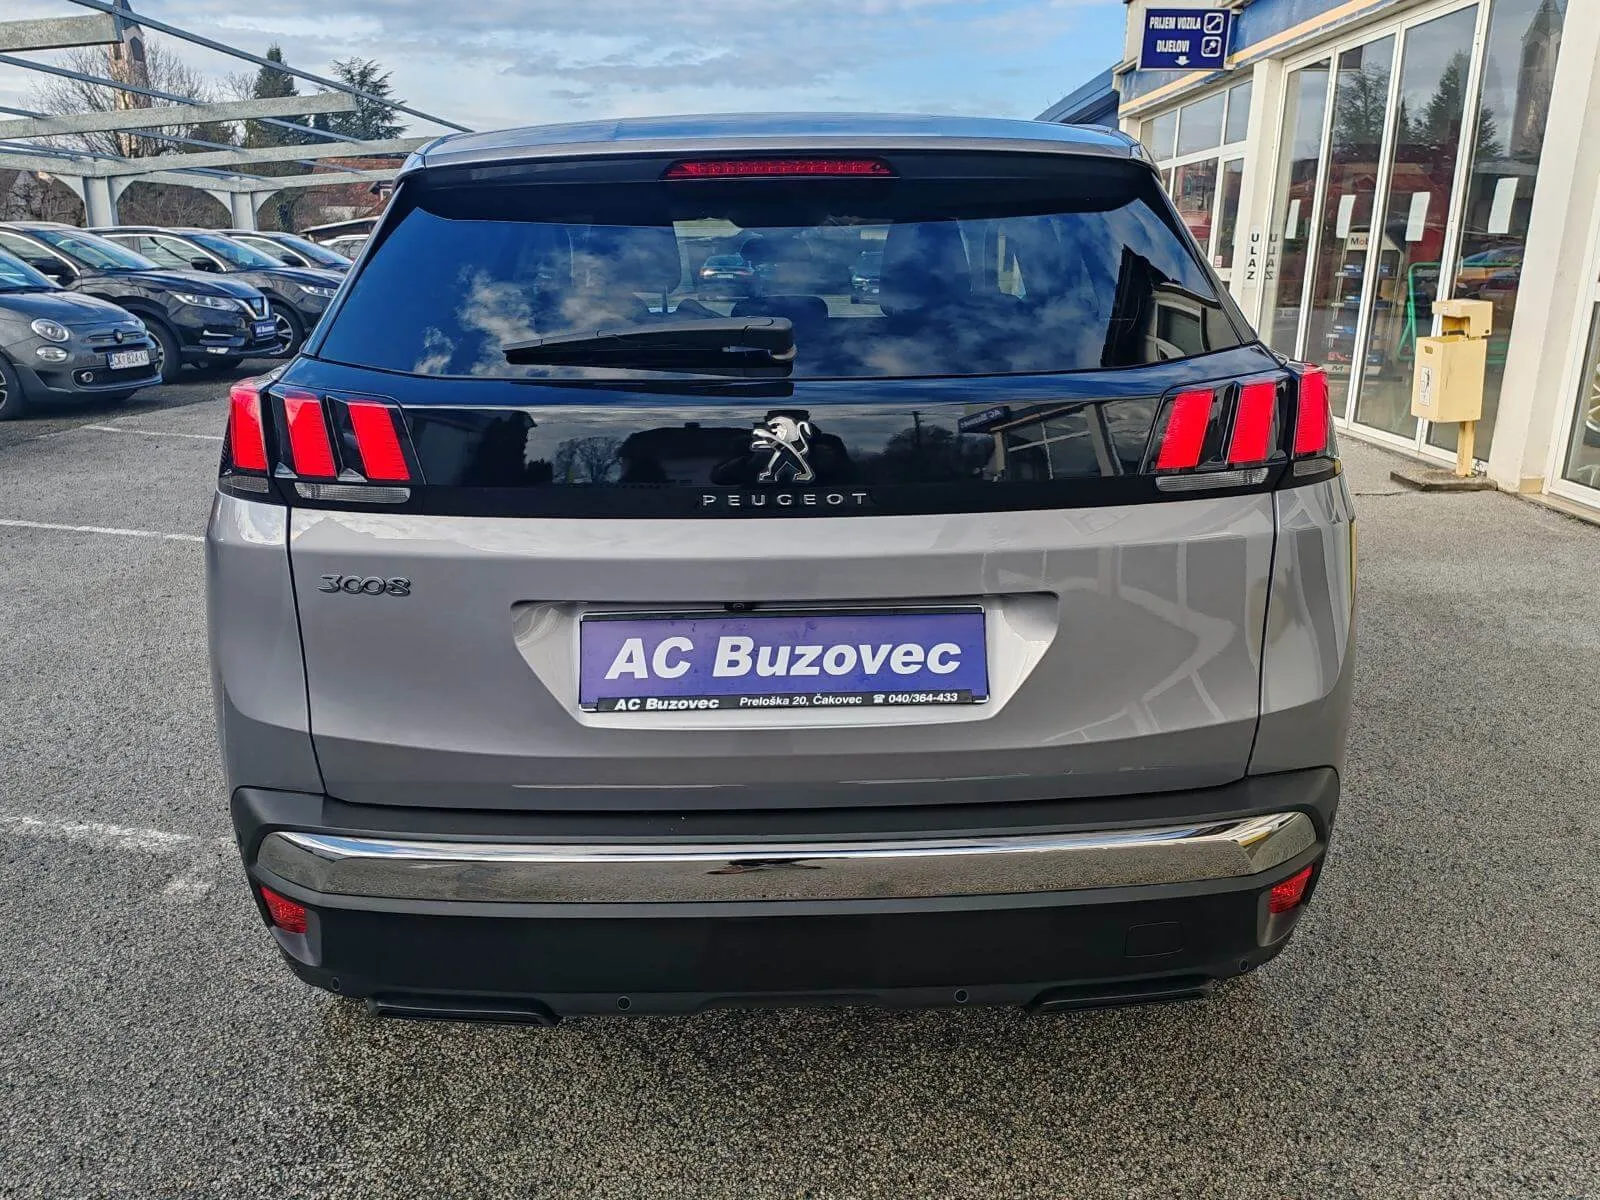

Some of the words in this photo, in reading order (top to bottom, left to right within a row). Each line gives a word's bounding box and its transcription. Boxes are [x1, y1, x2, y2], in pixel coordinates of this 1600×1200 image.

[1149, 16, 1176, 29] PRIJEM
[1177, 17, 1201, 30] VOZILA
[1156, 40, 1190, 53] DIJELOVI
[1247, 233, 1260, 280] ULAZ
[702, 493, 867, 506] PEUGEOT
[317, 574, 411, 597] 3008
[604, 636, 694, 680] AC
[712, 636, 962, 678] Buzovec
[614, 699, 645, 711] AC
[645, 698, 720, 711] Buzovec
[739, 696, 789, 707] Preloška
[791, 696, 810, 707] 20,
[812, 693, 863, 705] Čakovec
[888, 692, 958, 704] 040/364-433
